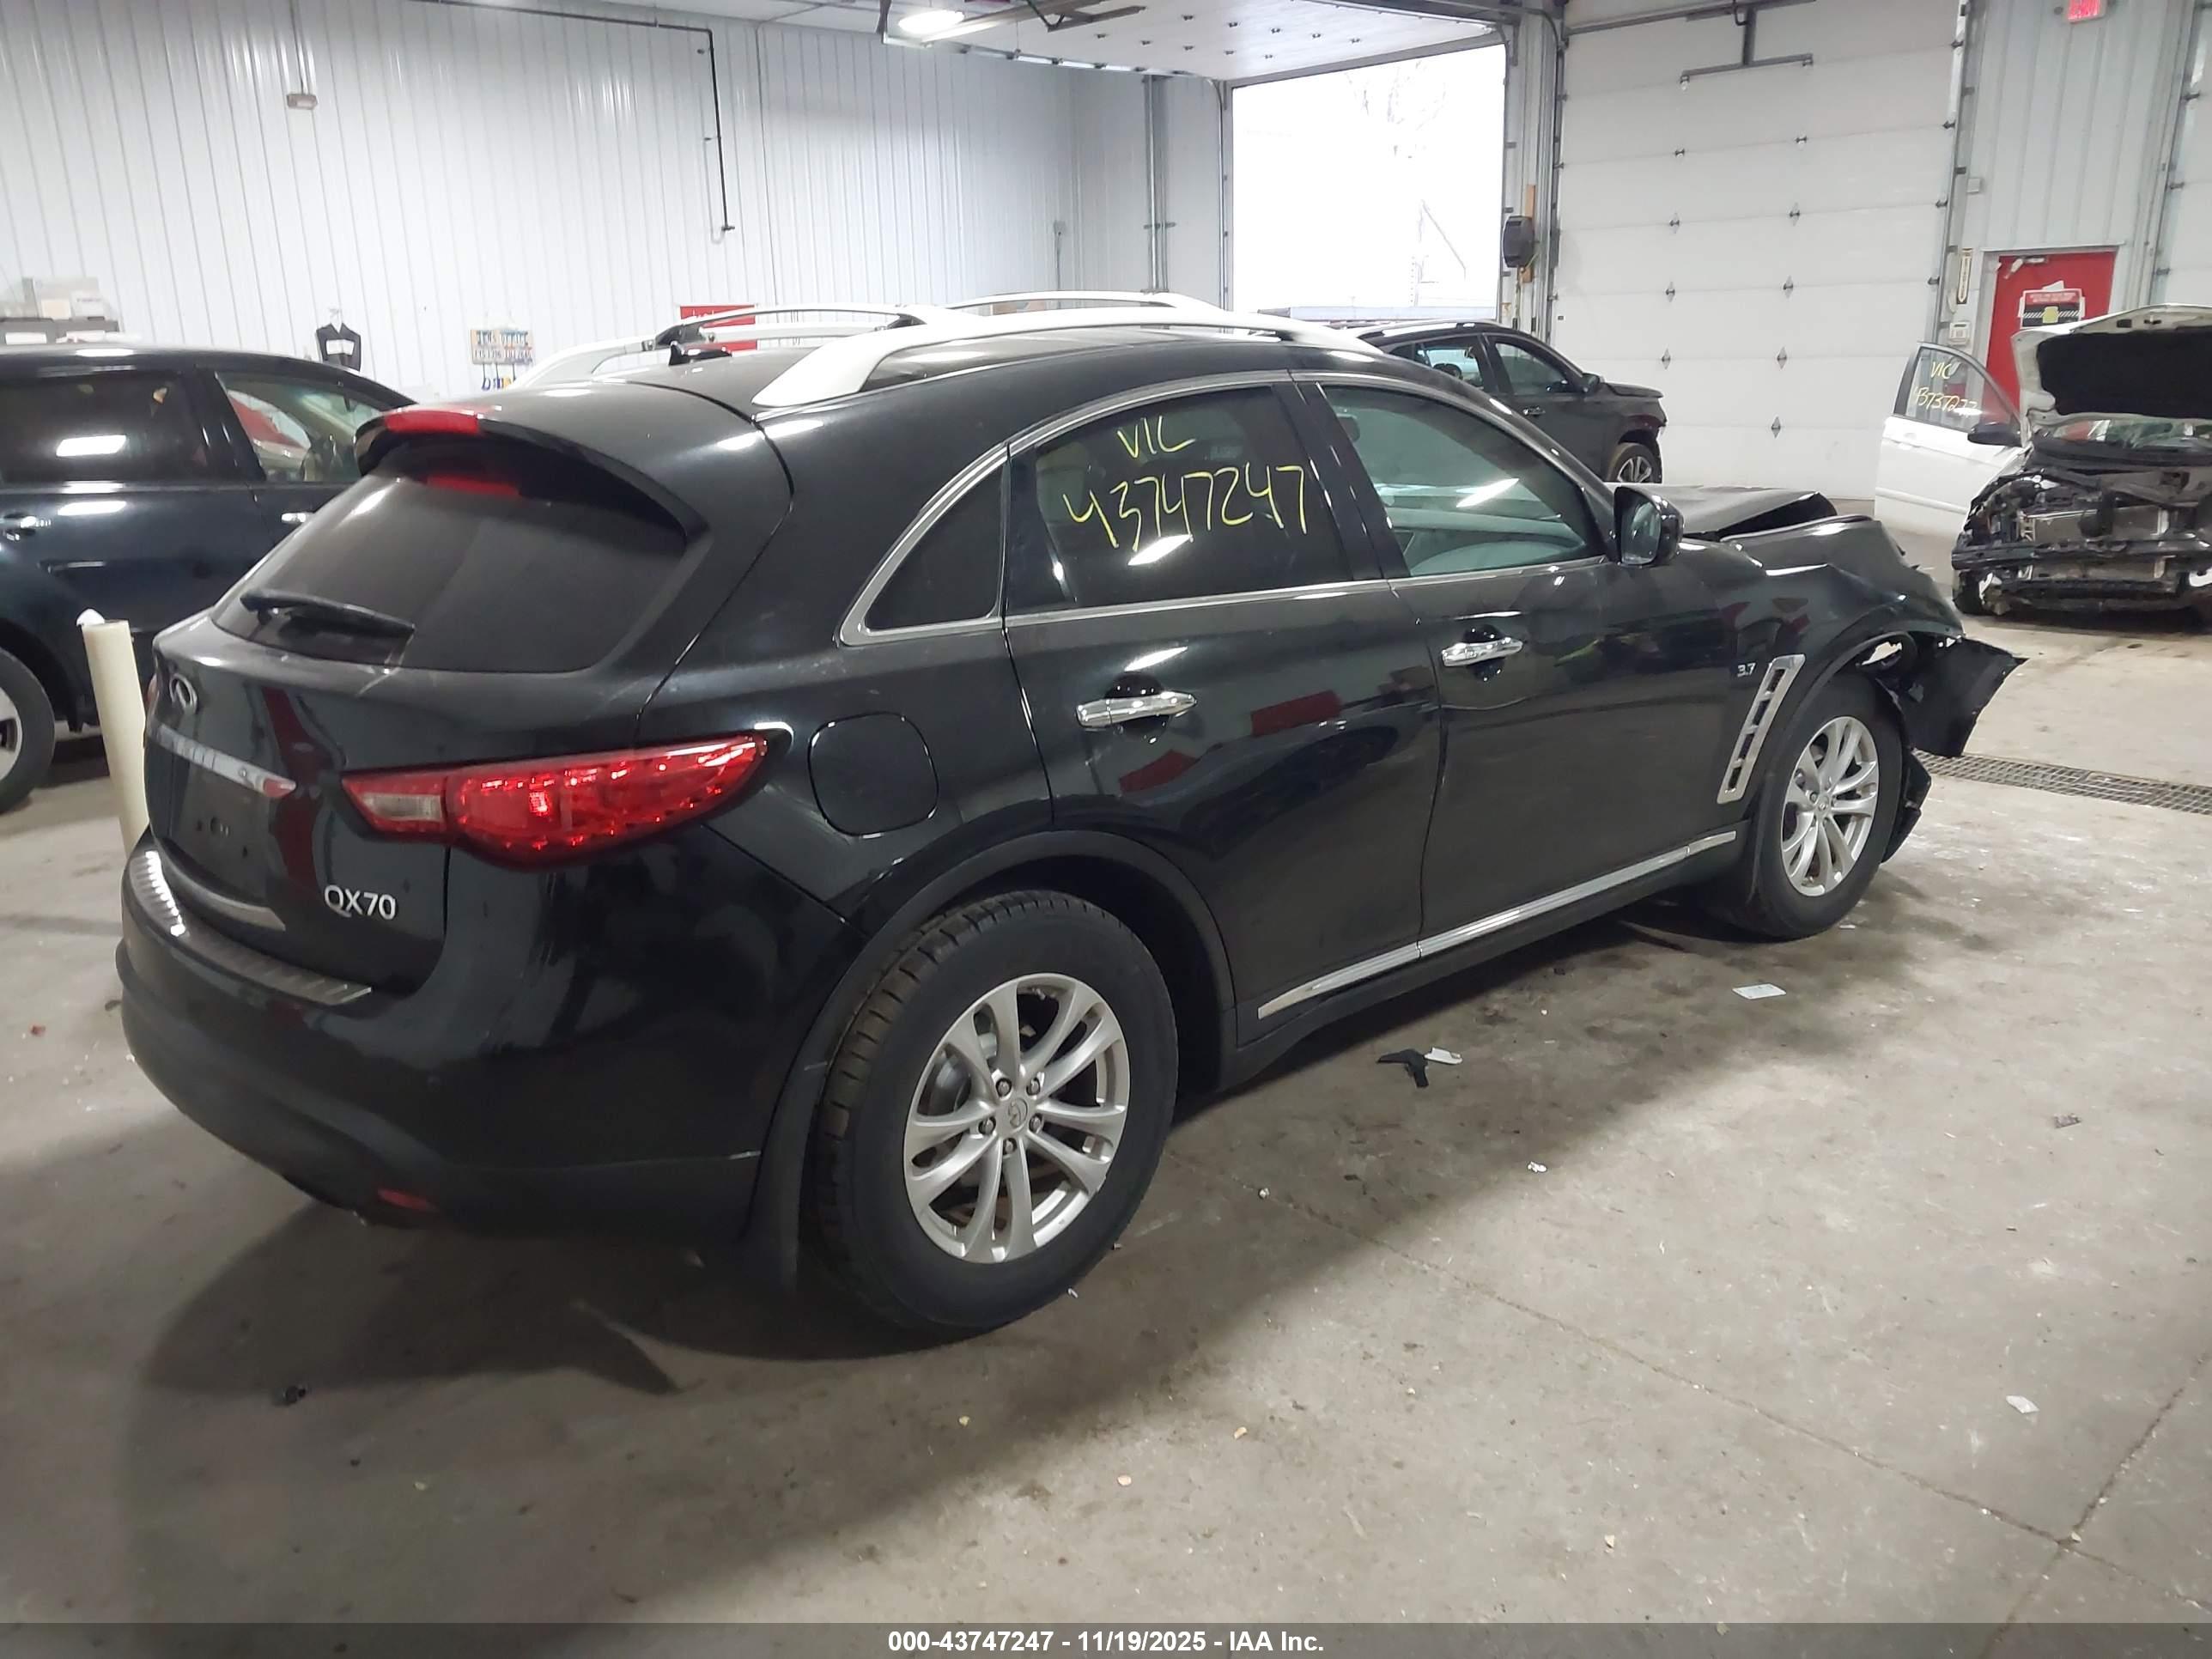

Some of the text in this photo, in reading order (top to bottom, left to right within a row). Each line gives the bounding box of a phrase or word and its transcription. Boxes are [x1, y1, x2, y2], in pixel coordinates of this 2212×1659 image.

[1930, 361, 1952, 379] VIC
[1062, 461, 1308, 552] 43747247
[1737, 662, 1757, 678] 3.7
[324, 884, 397, 920] QX70
